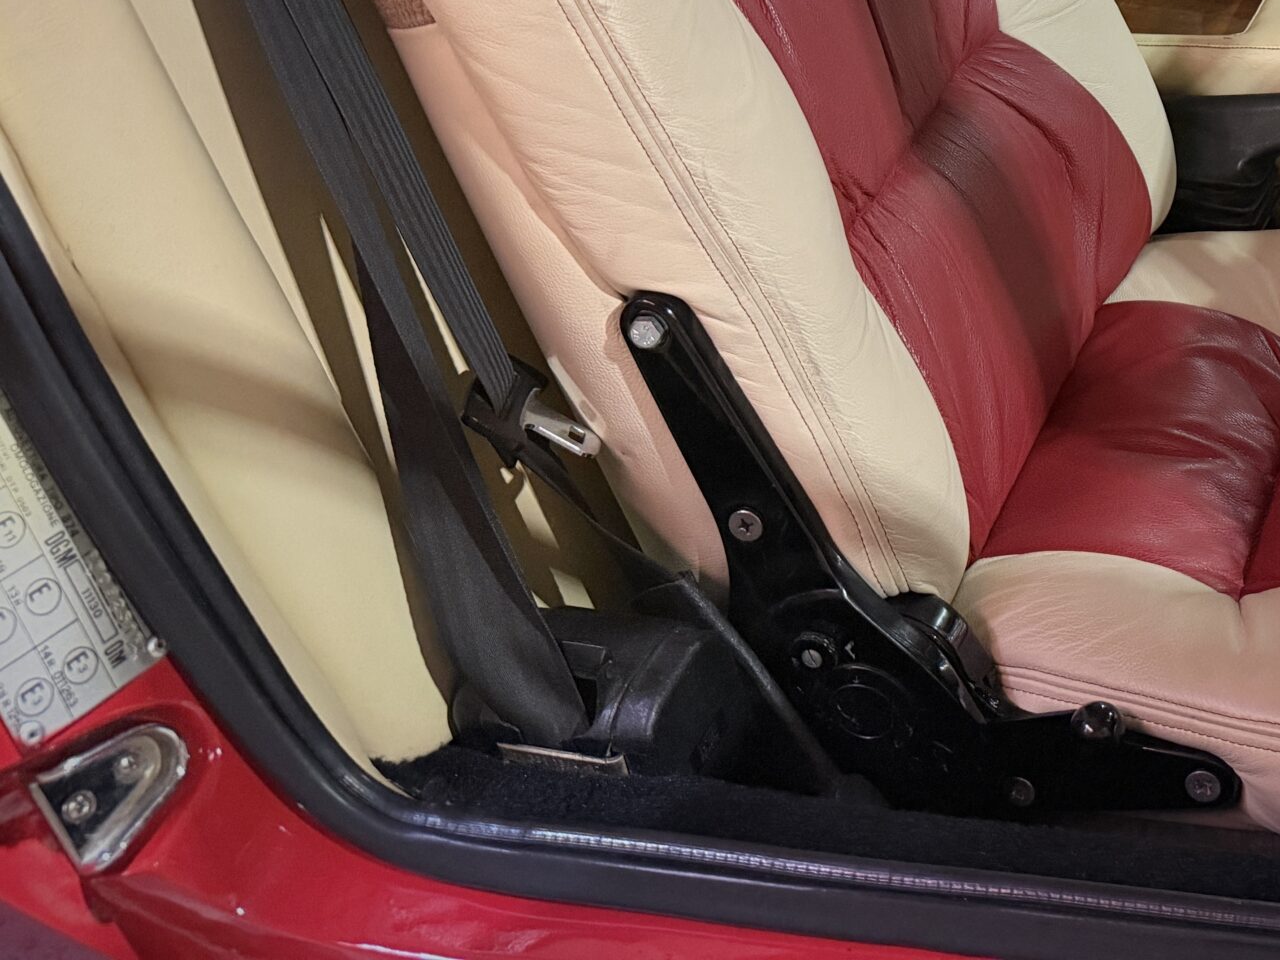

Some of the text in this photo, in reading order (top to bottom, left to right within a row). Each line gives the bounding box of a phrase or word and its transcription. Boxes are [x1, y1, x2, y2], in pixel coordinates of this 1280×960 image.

[10, 443, 59, 527] OMOLOGAZIONE
[45, 531, 78, 569] DGM
[82, 588, 103, 619] 11130
